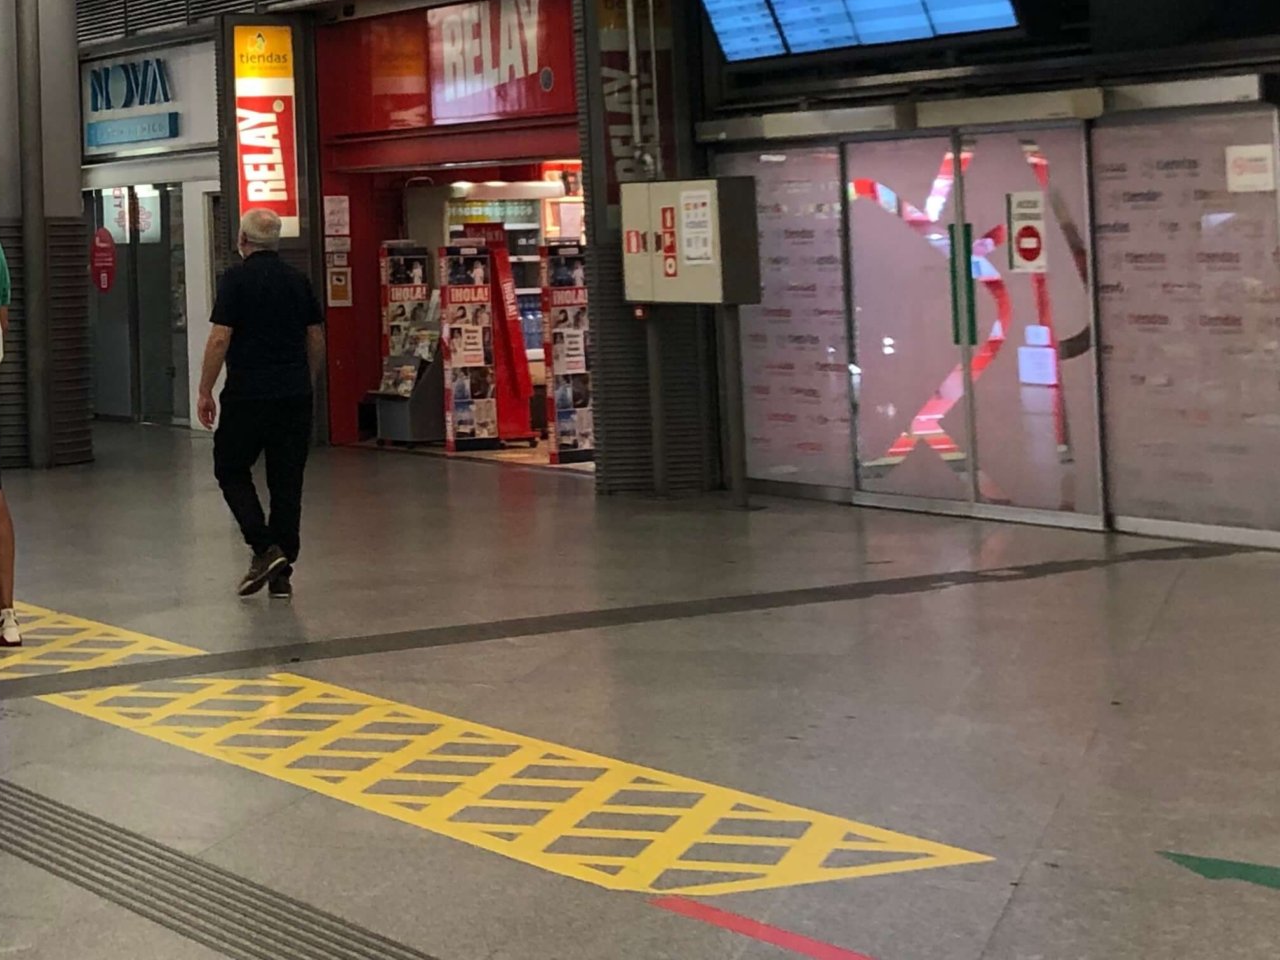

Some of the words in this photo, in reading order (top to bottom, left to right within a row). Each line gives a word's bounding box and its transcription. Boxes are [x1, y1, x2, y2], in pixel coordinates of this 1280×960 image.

[239, 51, 288, 64] tiendas
[90, 58, 171, 112] NOVA
[236, 107, 289, 202] RELAY
